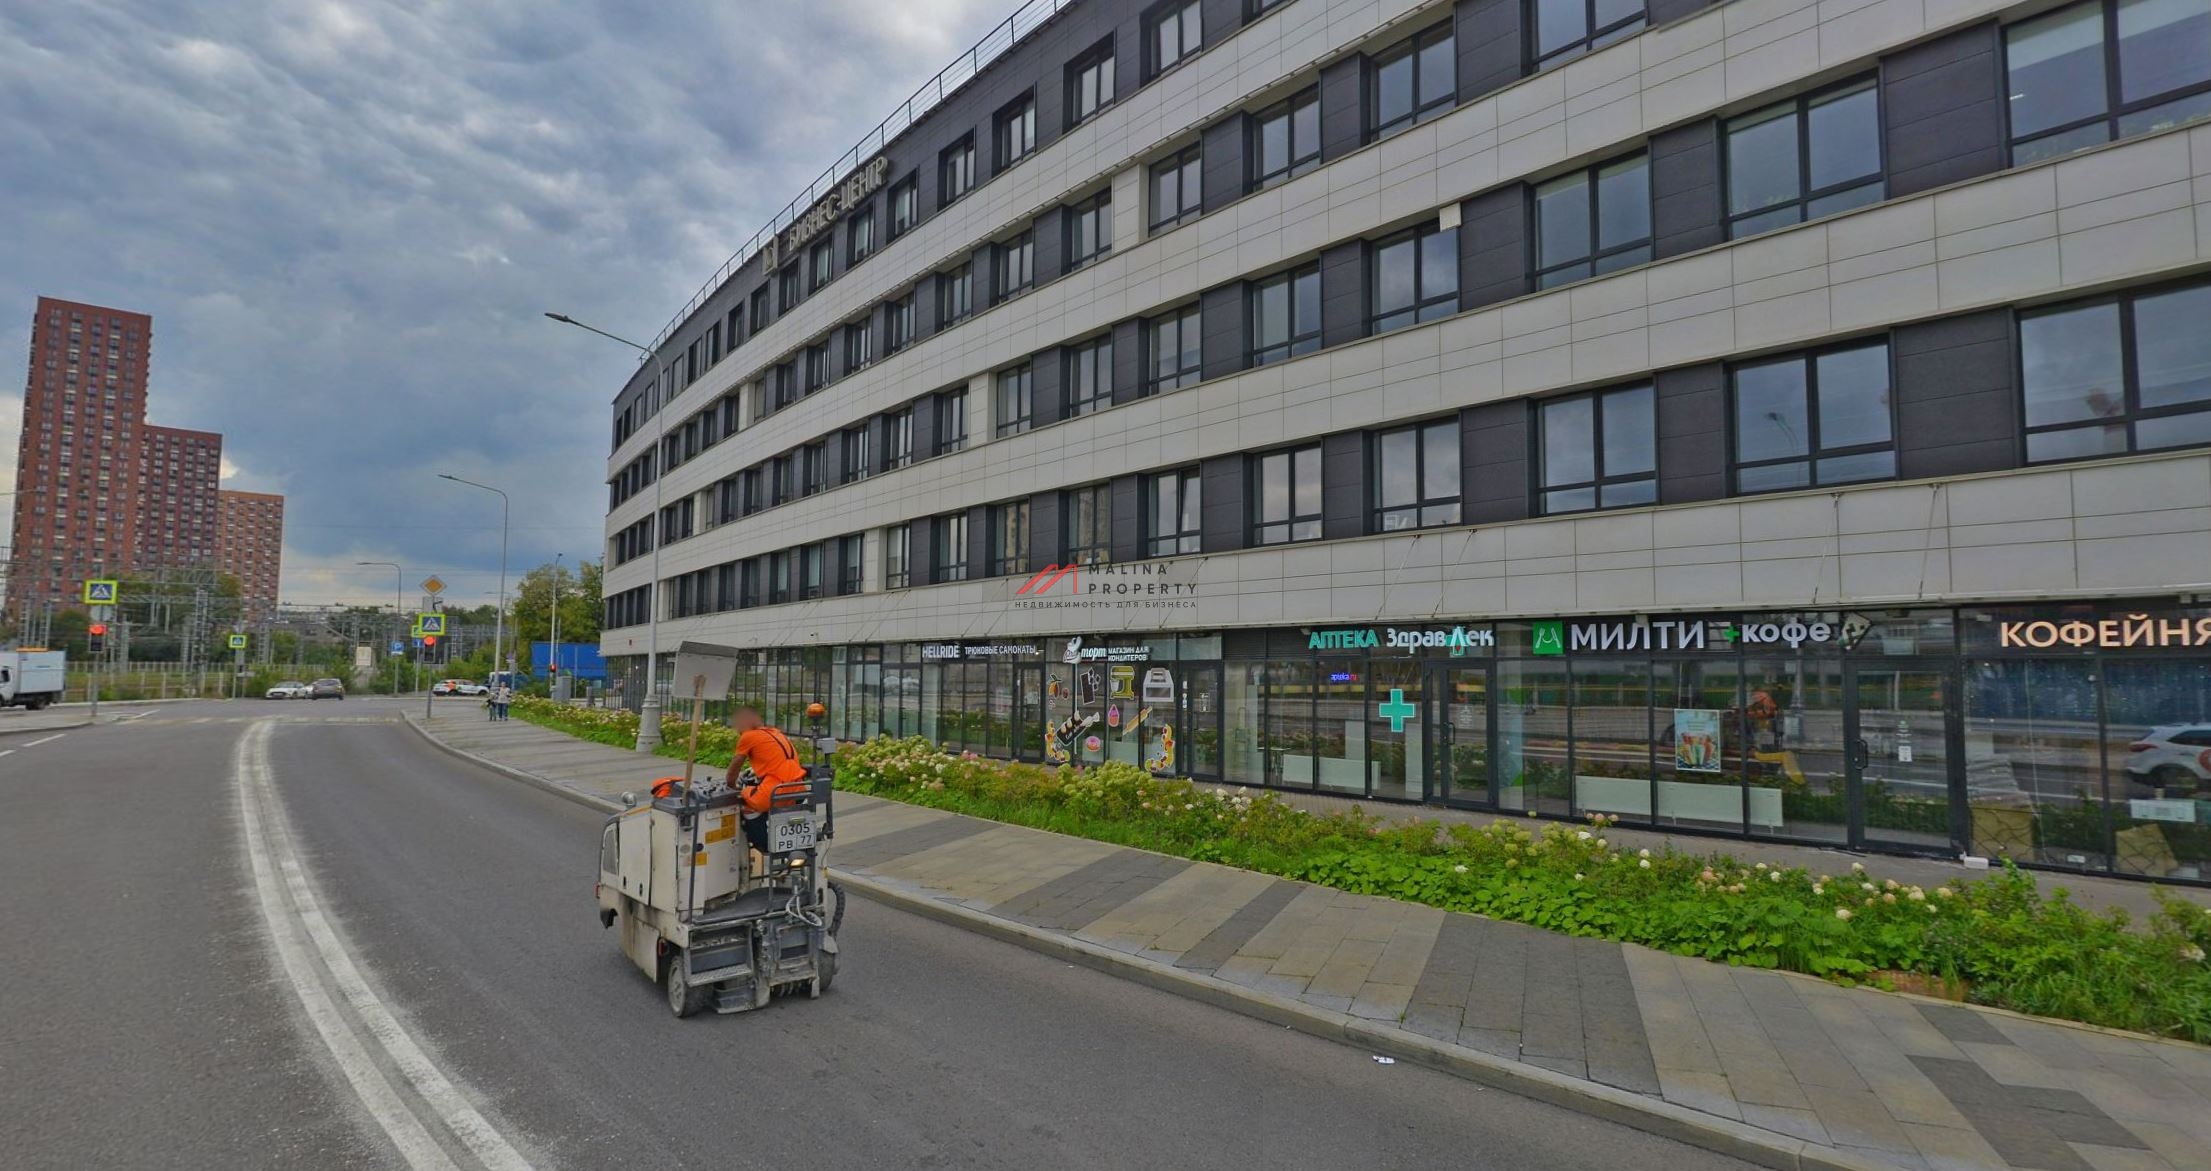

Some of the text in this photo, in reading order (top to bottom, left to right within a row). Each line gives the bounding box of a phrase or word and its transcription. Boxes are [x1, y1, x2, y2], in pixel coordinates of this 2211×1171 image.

[789, 156, 889, 251] БИЗНЕС-ЦЕНТР
[1571, 620, 1704, 651] МИЛТИ
[2001, 614, 2211, 648] КОФЕЙНЯ
[1308, 629, 1380, 649] АПТЕКА
[922, 645, 960, 659] HELLRIDE
[964, 645, 1036, 655] ТРЮКОВЫЕ САМОКАТЫ
[1081, 647, 1107, 662] торт
[1107, 646, 1149, 655] МАГАЗИН ДЛЯ
[1107, 654, 1148, 662] КОНДИТЕРОВ
[781, 823, 810, 836] 0305
[800, 835, 812, 844] 77
